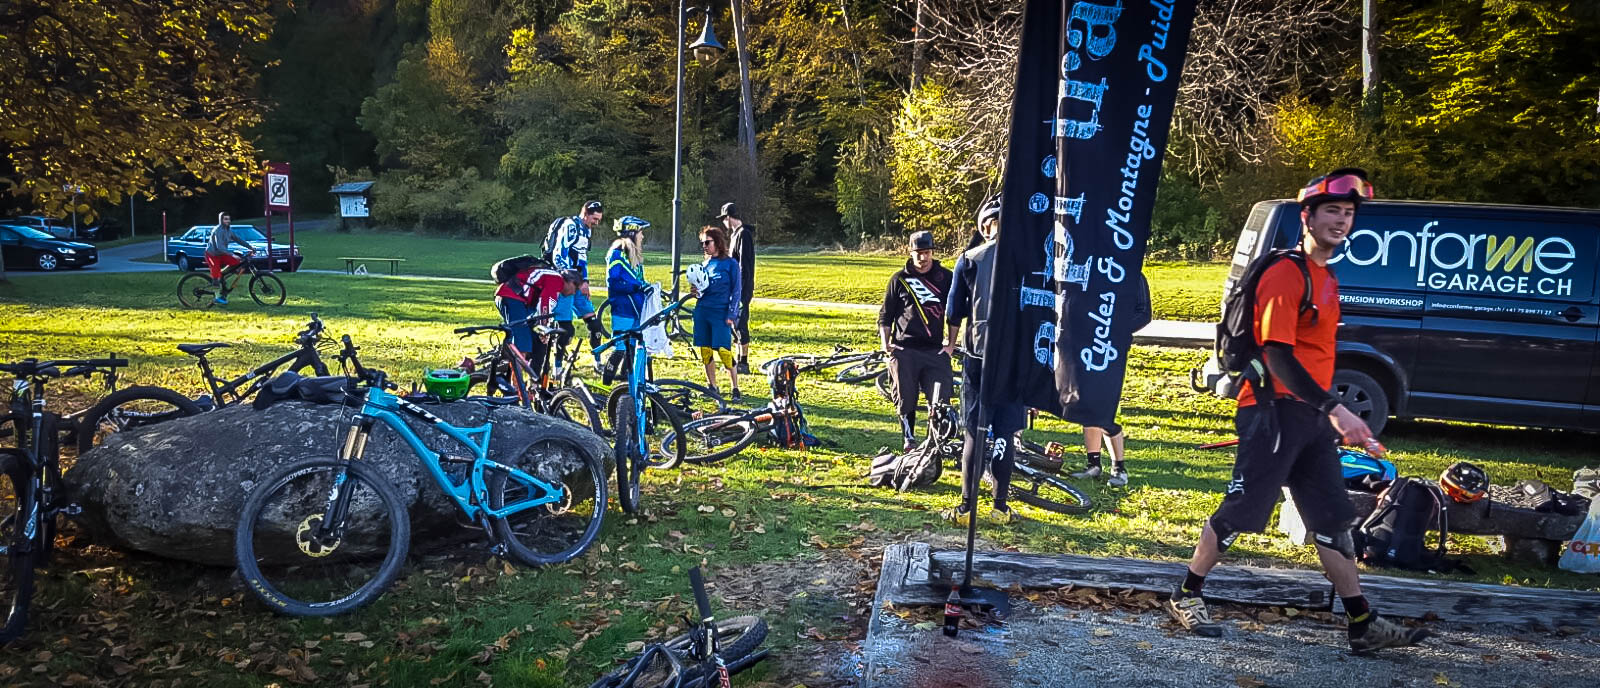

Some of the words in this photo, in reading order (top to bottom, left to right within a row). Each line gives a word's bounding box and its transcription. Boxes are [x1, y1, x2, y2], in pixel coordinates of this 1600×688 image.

[1106, 104, 1155, 250] Montagne
[1098, 256, 1125, 283] &
[905, 278, 941, 304] FOX
[1428, 272, 1572, 296] GARAGE.CH
[1376, 297, 1424, 307] WORKSHOP
[1081, 290, 1118, 372] Cycles
